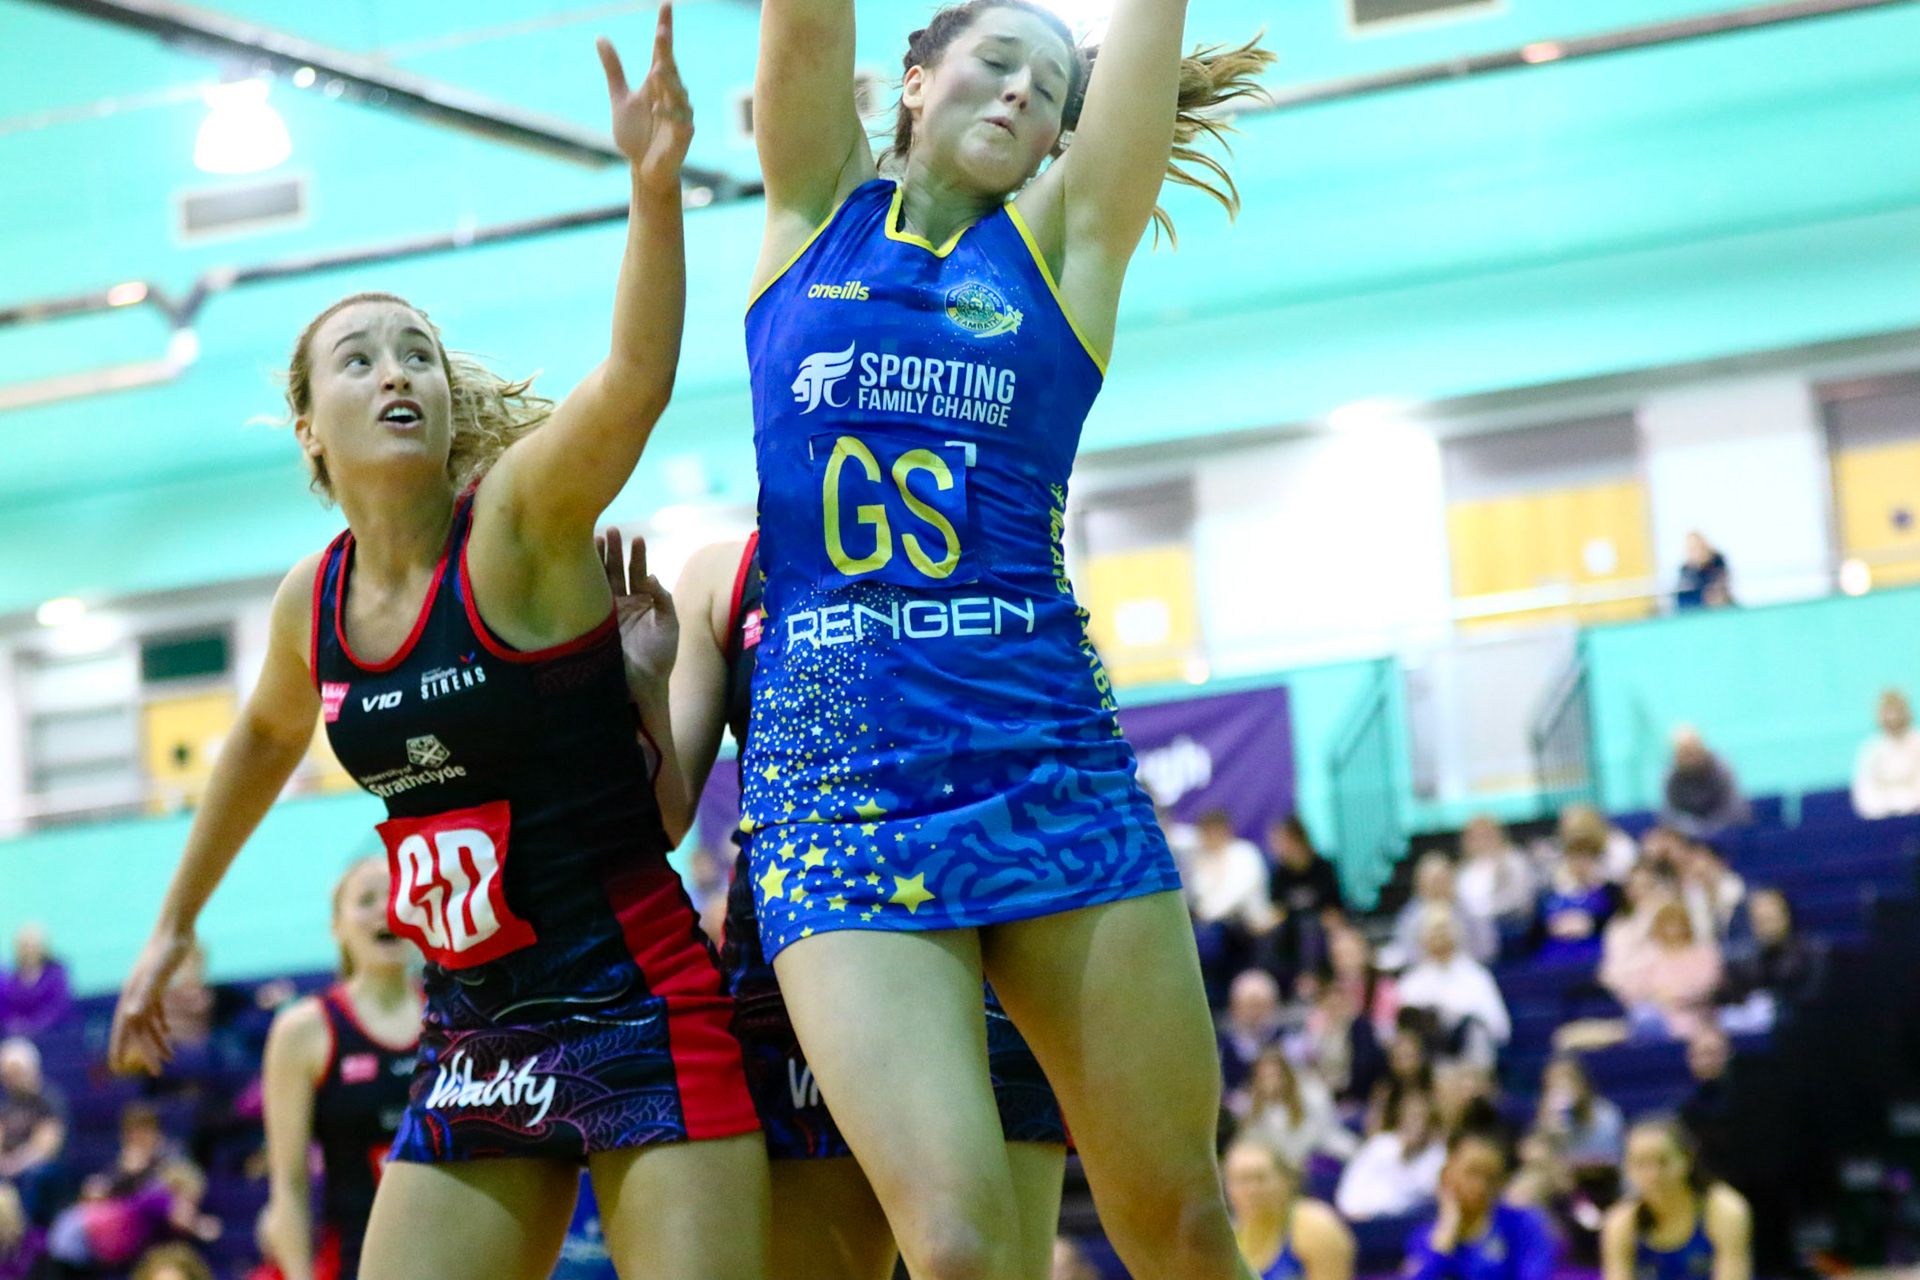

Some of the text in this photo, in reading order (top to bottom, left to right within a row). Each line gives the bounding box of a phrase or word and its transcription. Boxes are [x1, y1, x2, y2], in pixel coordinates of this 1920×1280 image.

[858, 351, 1017, 405] SPORTING
[858, 387, 1012, 428] FAMILY CHANGE
[822, 435, 962, 580] GS
[786, 596, 1035, 654] RENGEN
[421, 666, 486, 700] SIRENS
[369, 765, 467, 798] Strathclyde
[395, 828, 501, 953] GD
[425, 1049, 557, 1127] Vitality
